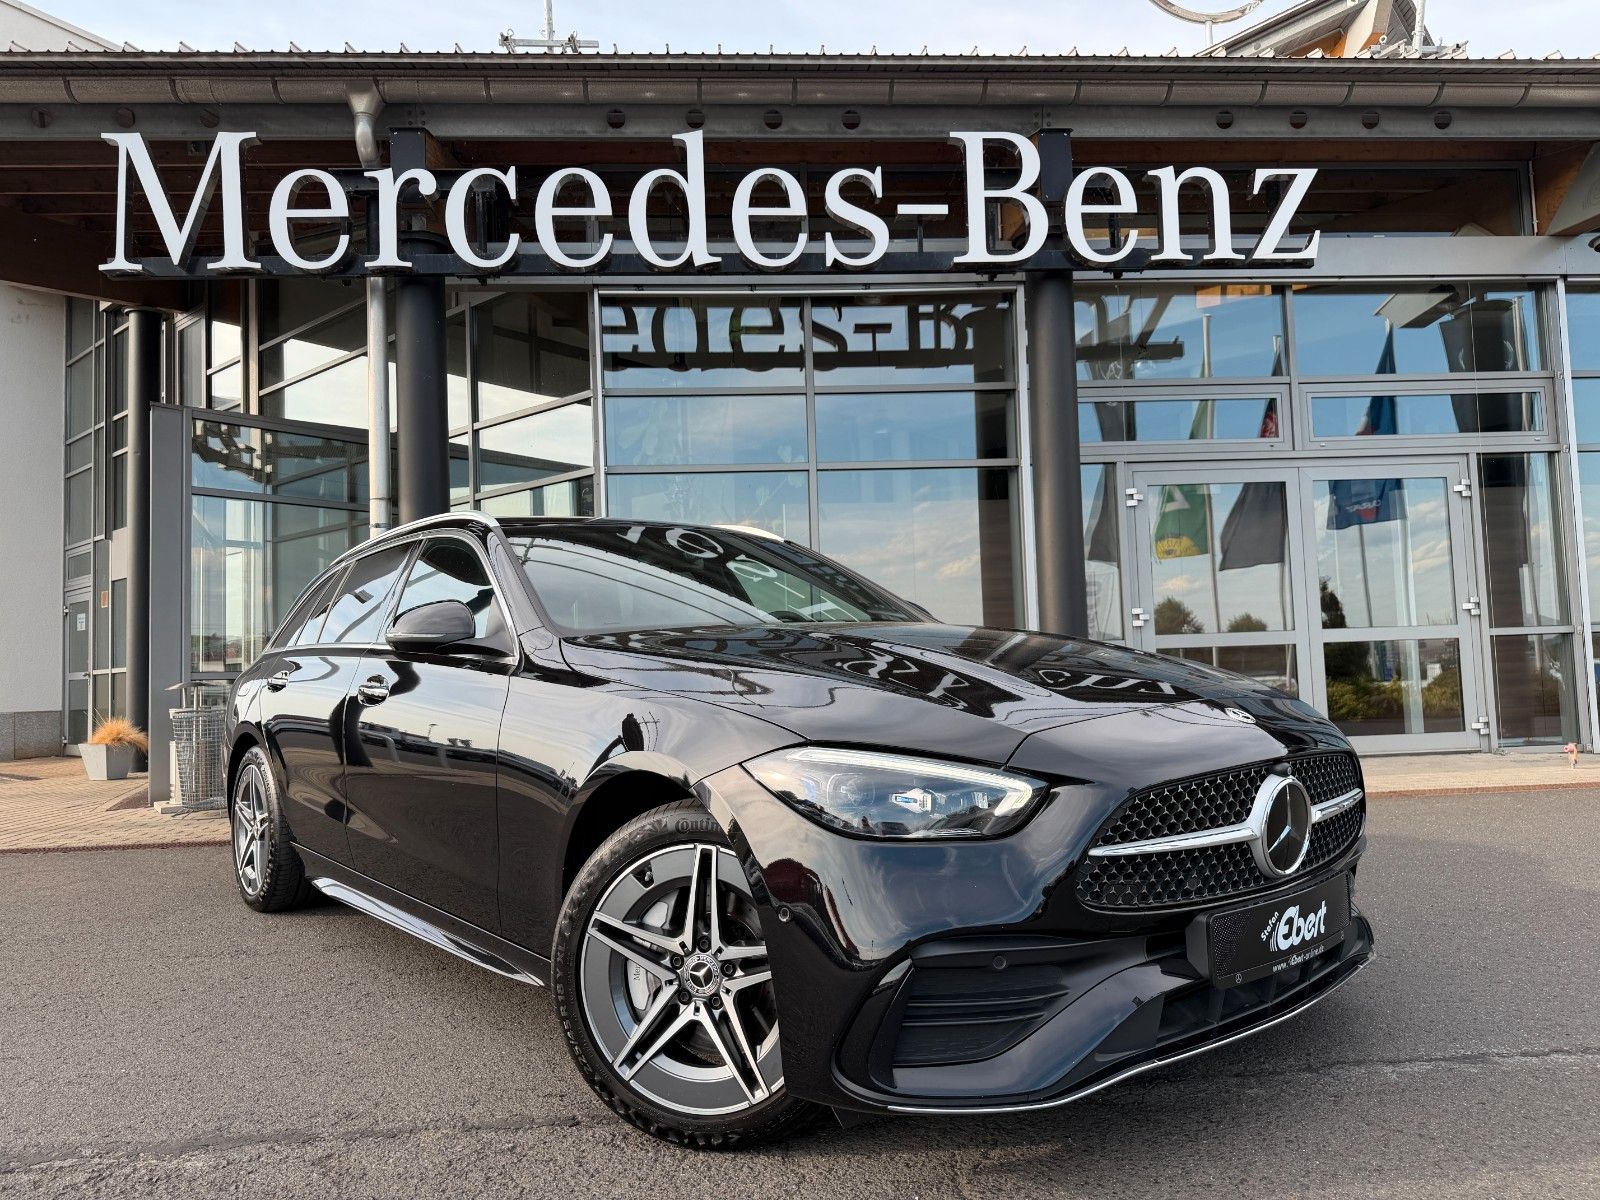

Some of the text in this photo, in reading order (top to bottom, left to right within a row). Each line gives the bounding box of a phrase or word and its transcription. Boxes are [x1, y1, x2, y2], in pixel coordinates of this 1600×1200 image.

[98, 130, 1321, 272] Mercedes-Benz
[1261, 911, 1279, 941] Stefan
[1277, 900, 1327, 950] Ebert
